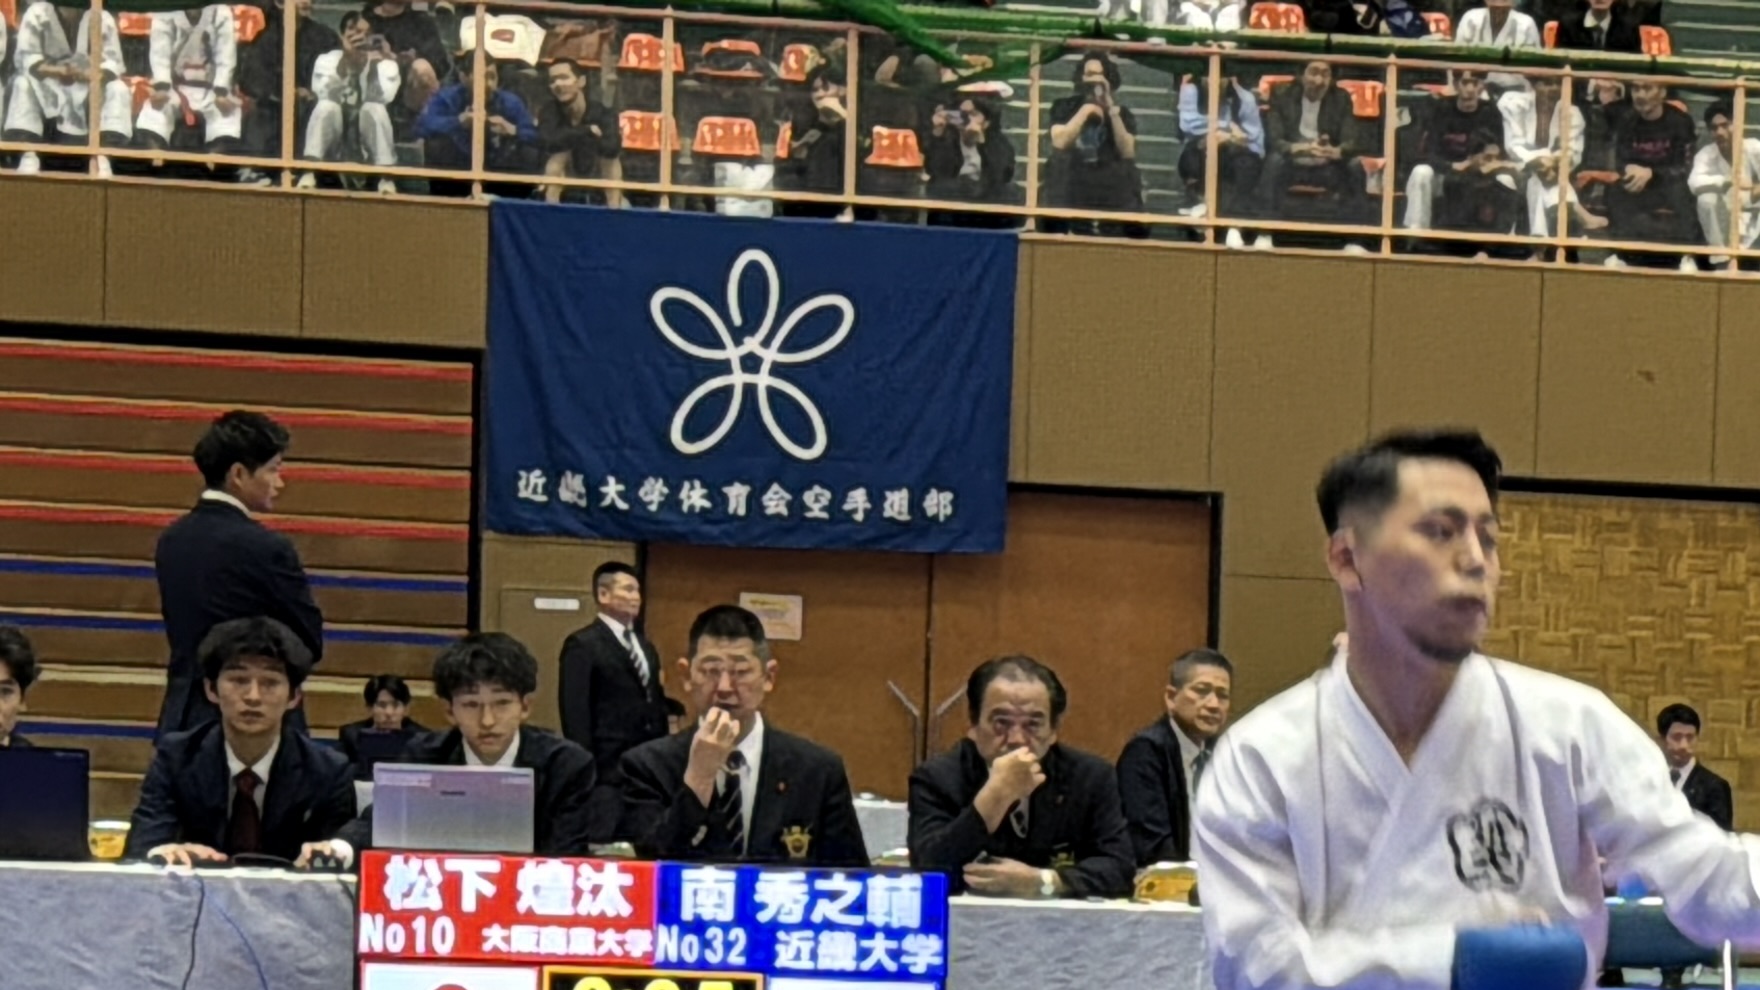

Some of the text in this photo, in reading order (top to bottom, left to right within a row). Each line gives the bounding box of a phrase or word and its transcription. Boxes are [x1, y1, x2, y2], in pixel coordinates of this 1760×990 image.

[517, 468, 955, 522] 近畿大学体育会空手道部
[383, 854, 501, 913] 松下
[680, 865, 736, 922] 南
[359, 913, 455, 955] No10
[656, 923, 747, 965] No32
[774, 929, 944, 975] 近畿大学
